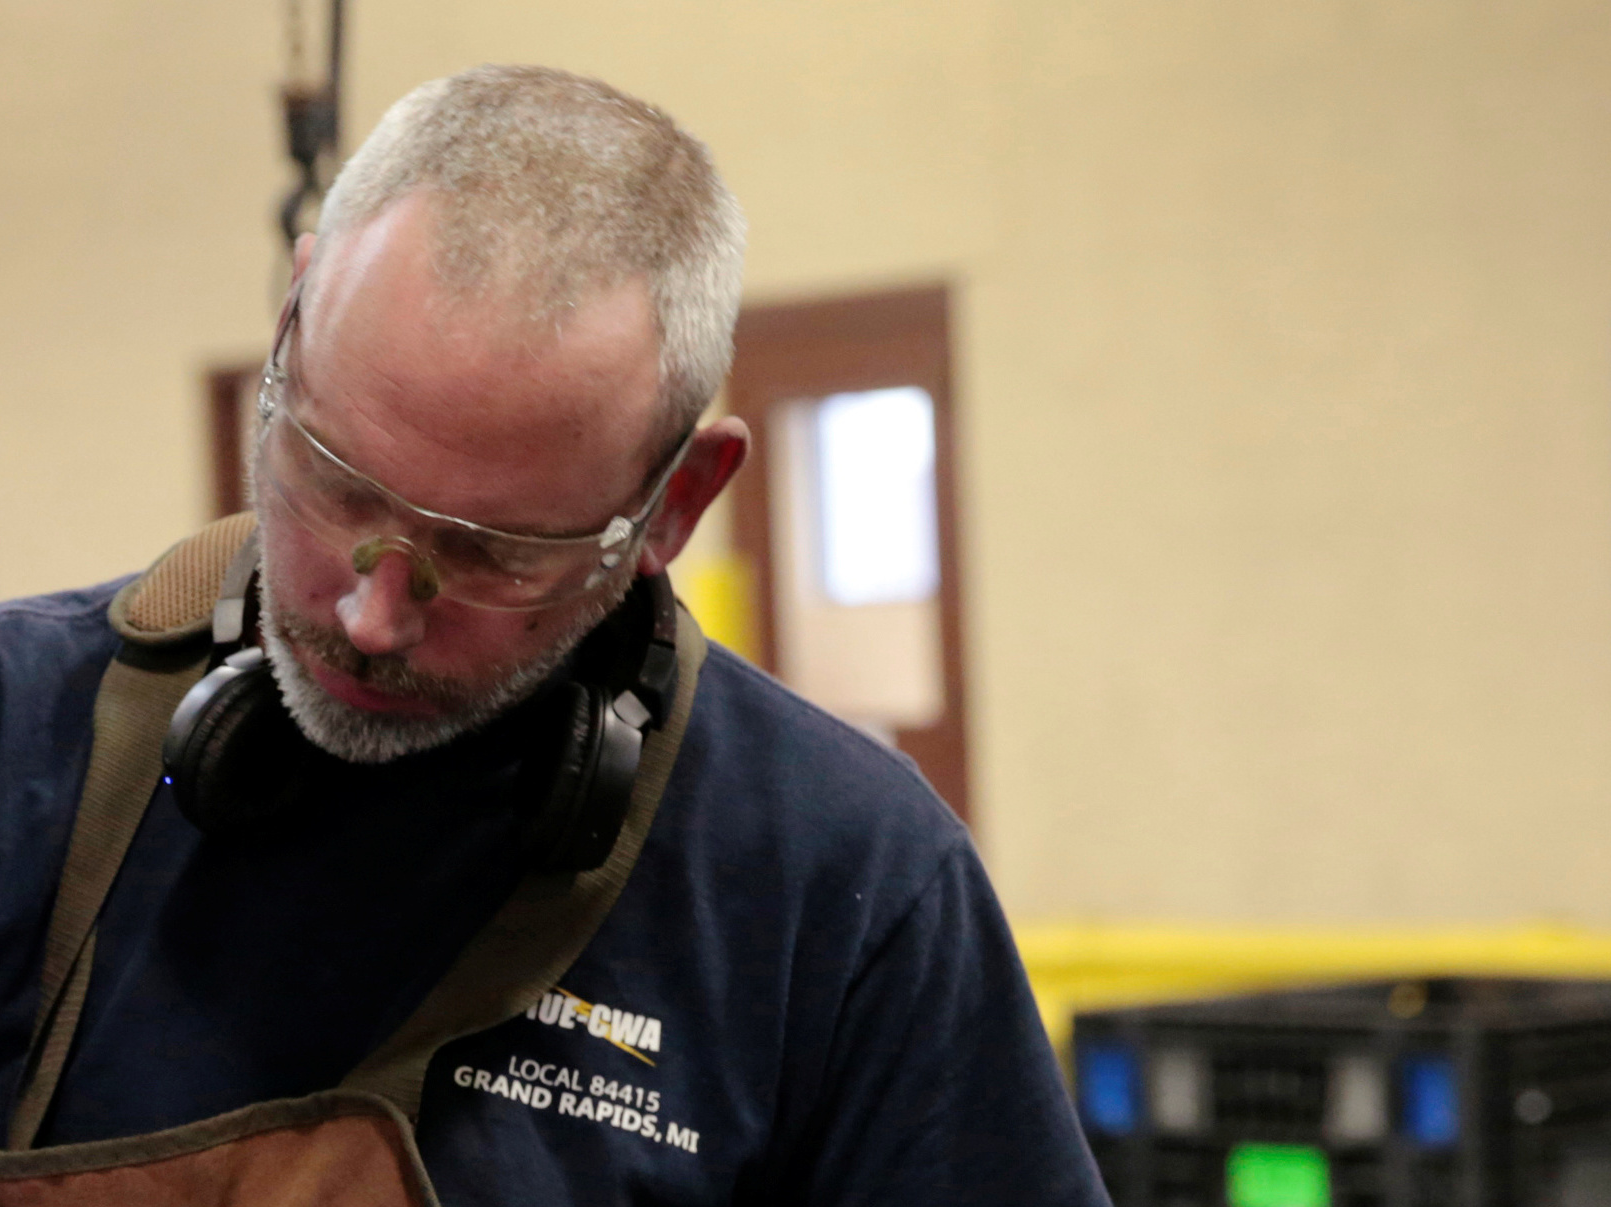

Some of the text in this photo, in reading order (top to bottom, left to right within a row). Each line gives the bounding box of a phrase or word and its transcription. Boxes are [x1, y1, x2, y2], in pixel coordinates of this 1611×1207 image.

[454, 1065, 700, 1154] GRAND RAPIDS, MI
[509, 1056, 661, 1113] LOCAL 84415
